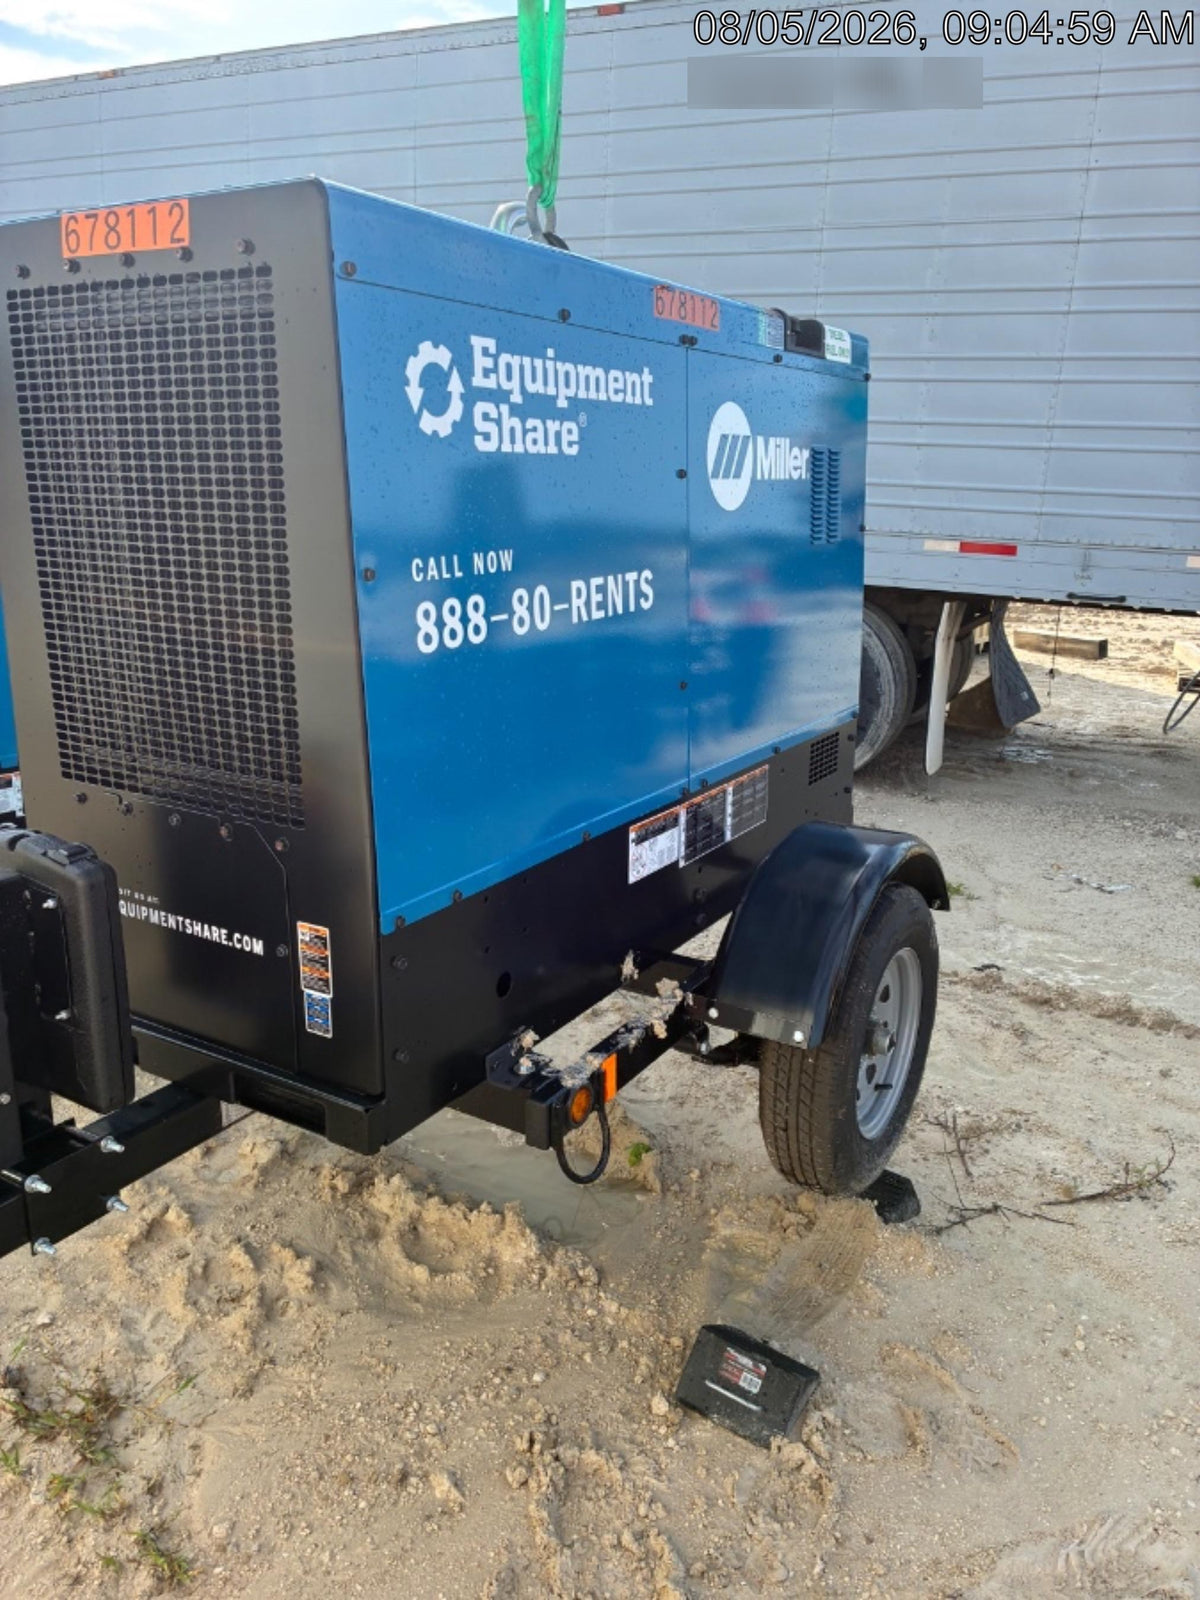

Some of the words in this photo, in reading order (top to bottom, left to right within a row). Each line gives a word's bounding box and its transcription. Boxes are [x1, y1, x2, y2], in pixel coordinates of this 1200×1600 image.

[64, 202, 186, 254] 678112
[655, 286, 719, 329] 678112
[470, 334, 653, 408] Equipment
[757, 435, 810, 480] Miller
[412, 555, 463, 582] CALL
[473, 549, 513, 575] NOW
[416, 569, 654, 653] 888-80-RENTS
[118, 899, 264, 956] QUIPMENTSHARE.COM
